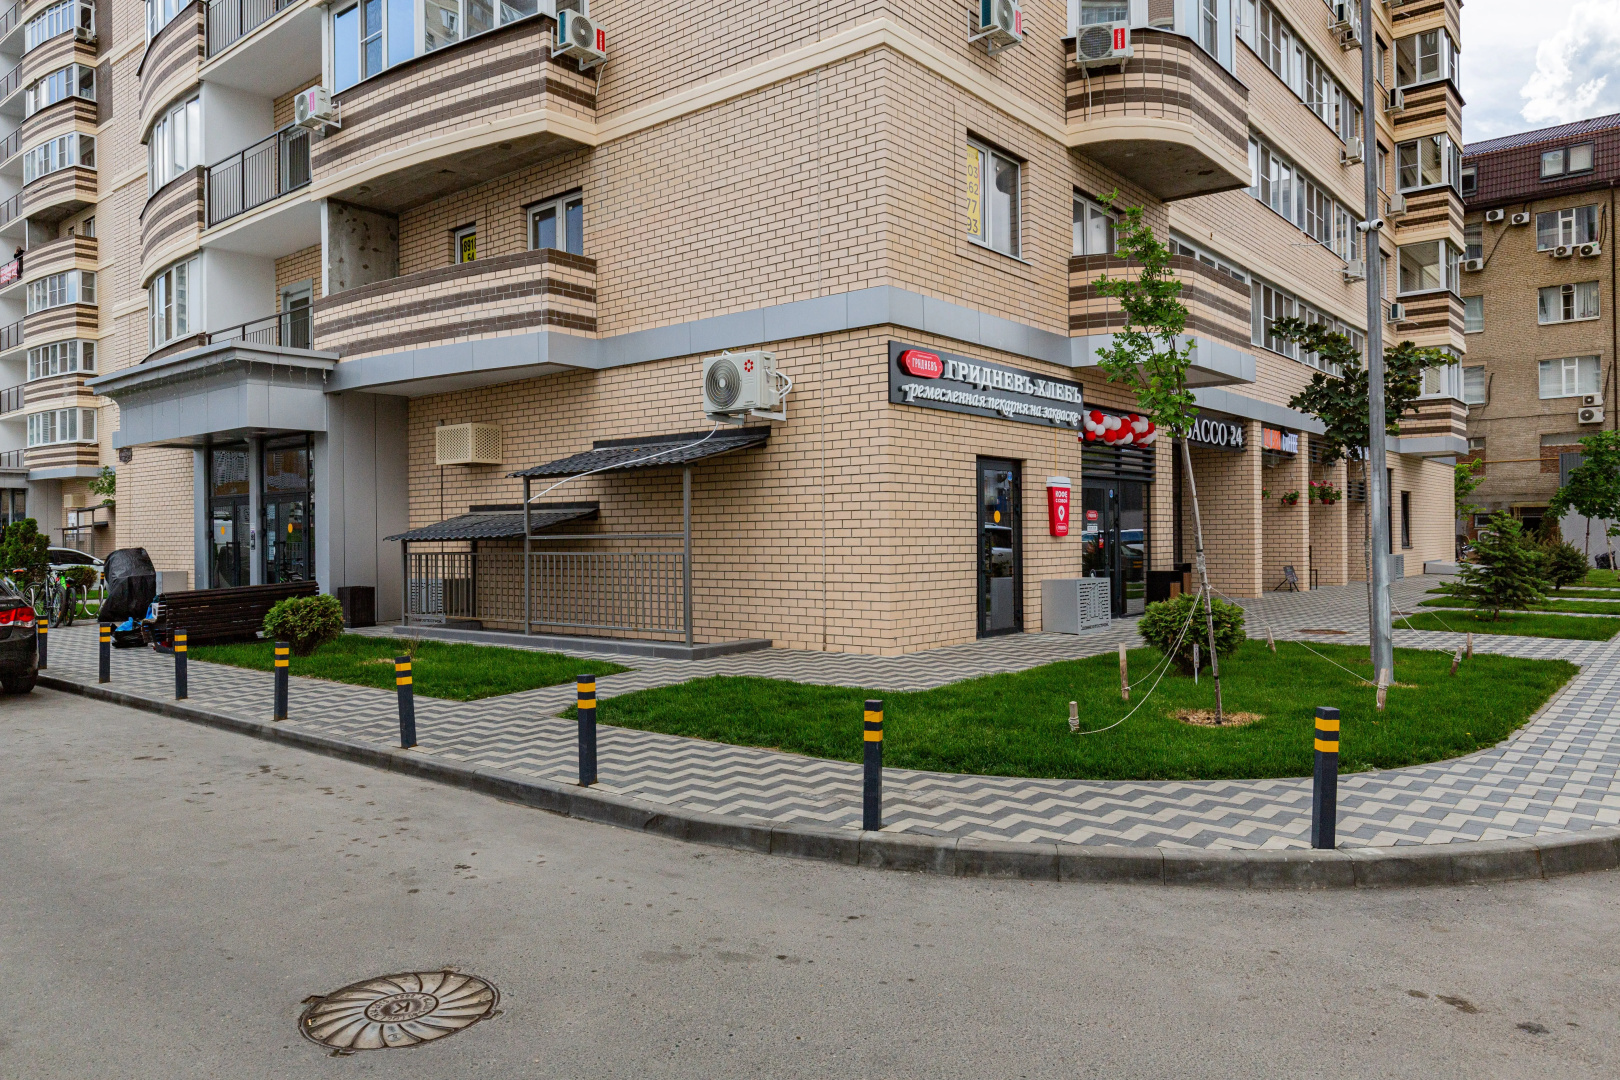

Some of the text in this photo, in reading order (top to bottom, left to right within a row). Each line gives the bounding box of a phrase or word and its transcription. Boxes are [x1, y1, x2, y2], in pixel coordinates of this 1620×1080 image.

[943, 360, 1082, 403] ГРИДНЕВЪ-ХЛЕБЪ
[988, 396, 1028, 418] пекарня
[1030, 404, 1042, 417] на
[1041, 406, 1078, 426] закваске
[1230, 425, 1243, 448] 24
